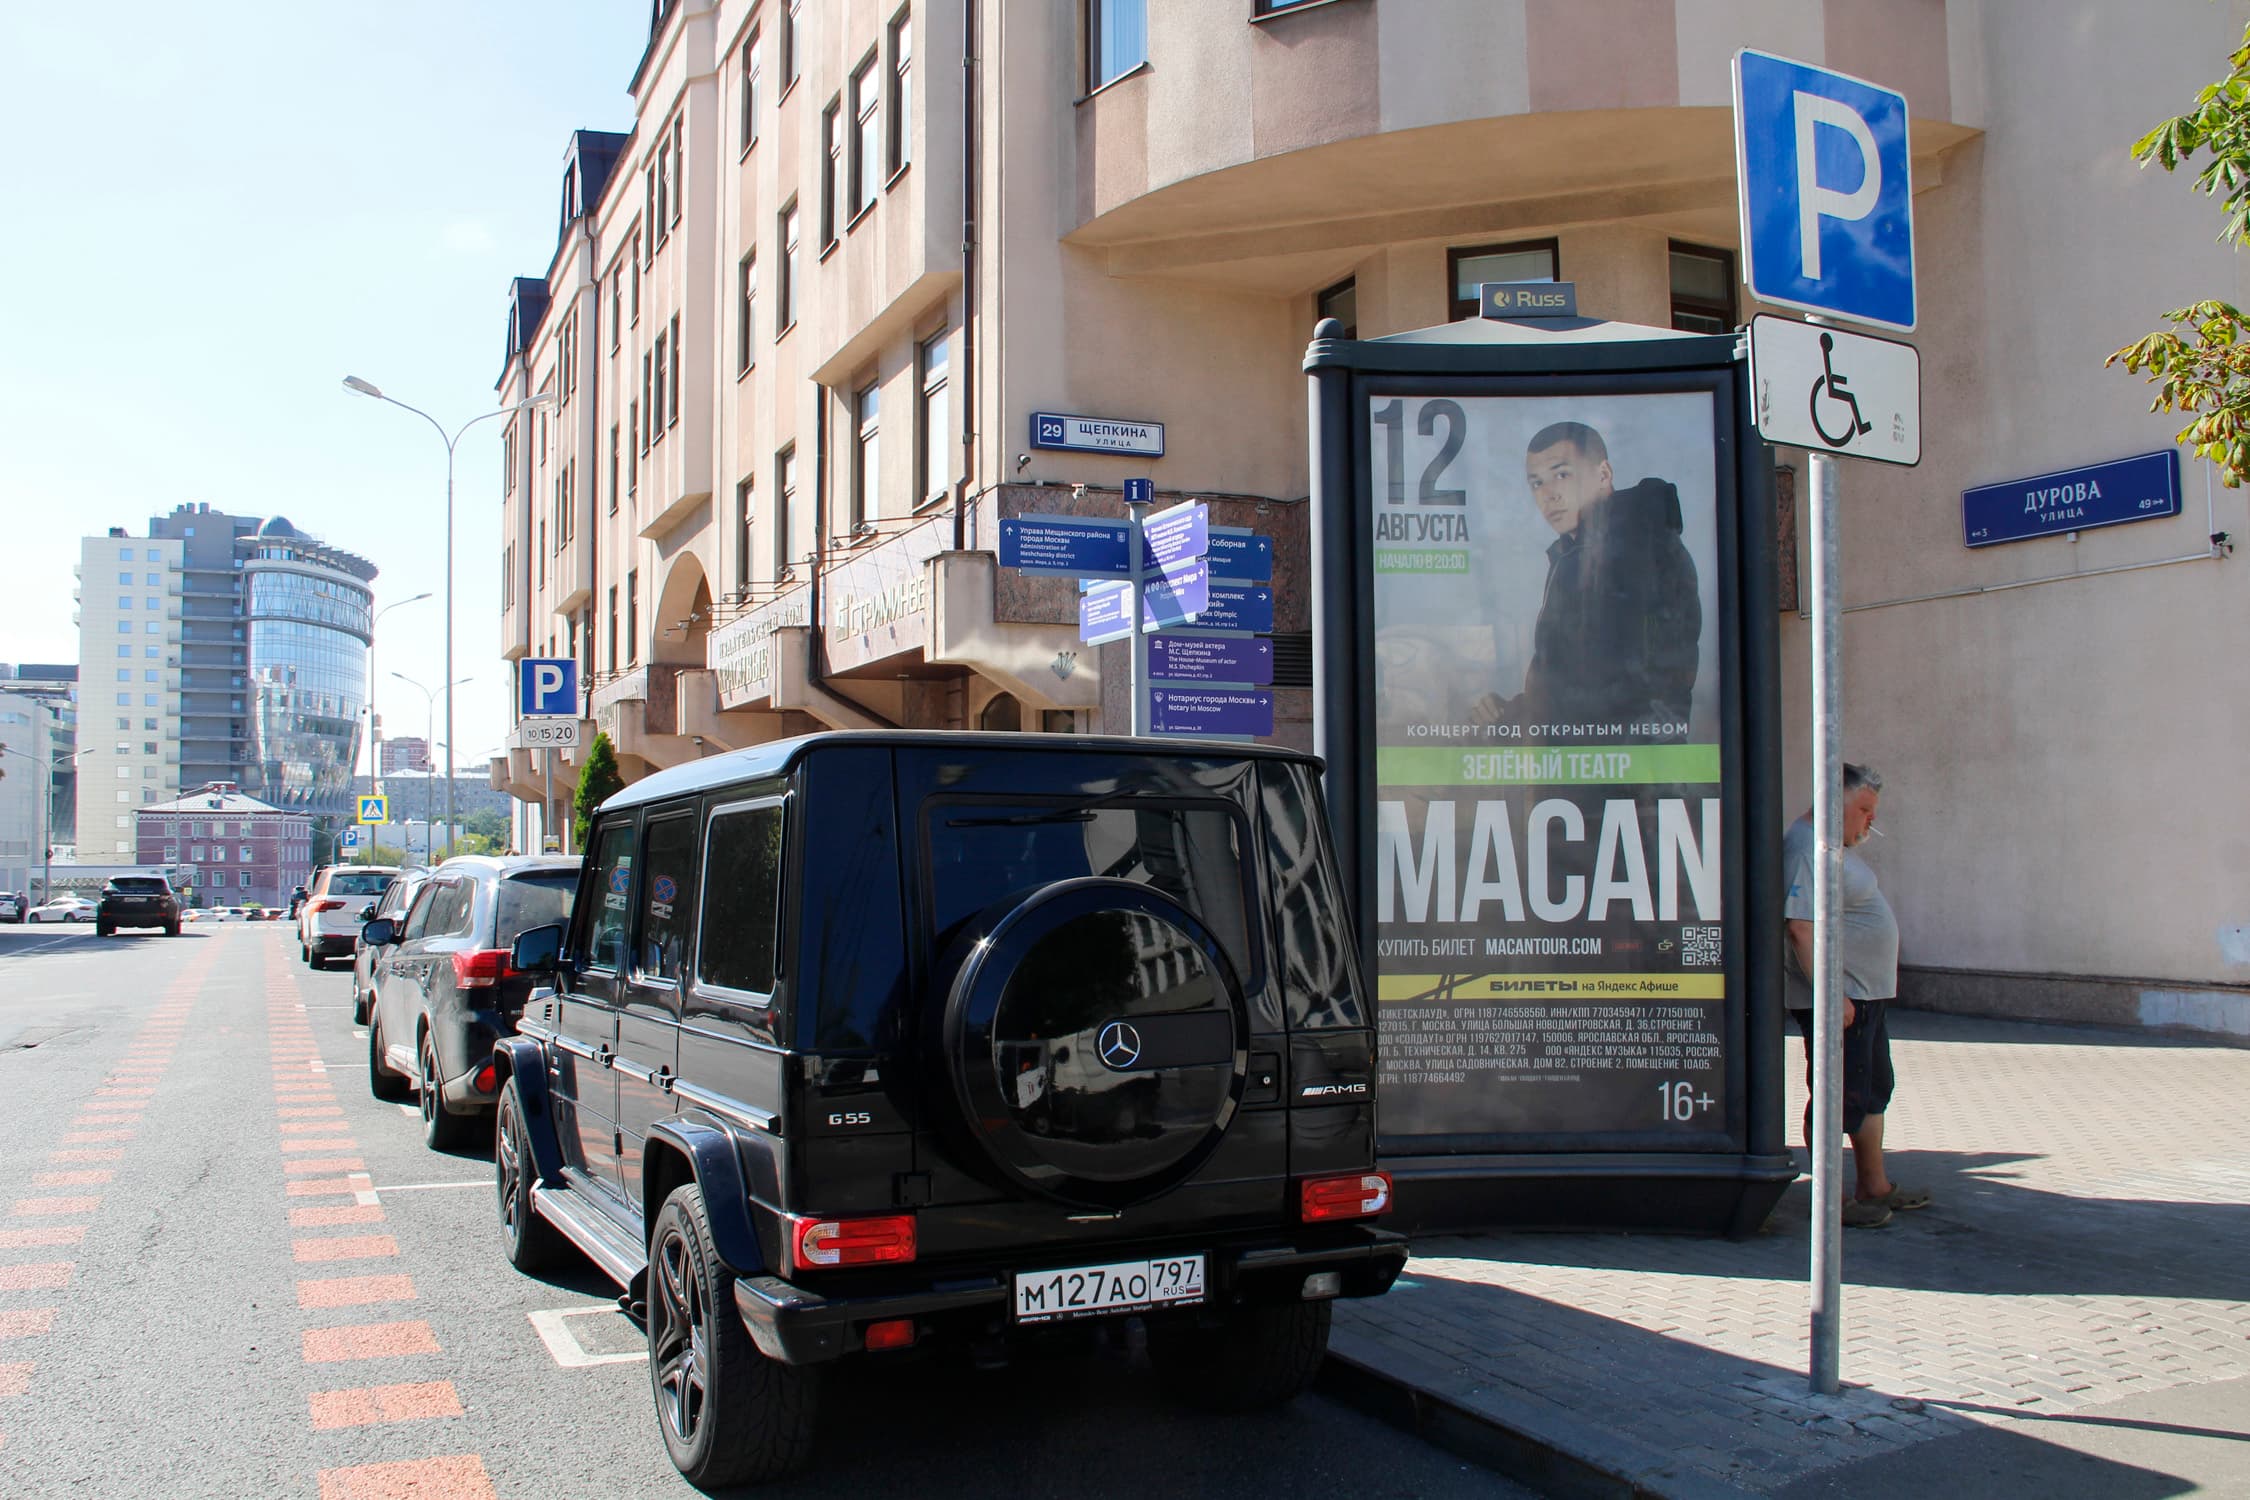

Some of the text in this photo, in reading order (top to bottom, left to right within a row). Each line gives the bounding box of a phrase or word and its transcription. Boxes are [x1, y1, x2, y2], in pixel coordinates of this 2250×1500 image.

[1793, 90, 1882, 280] P
[1517, 291, 1566, 307] Russ
[1042, 424, 1062, 437] 29
[1080, 423, 1147, 438] ЩЕПКИНА
[1095, 438, 1132, 447] УЛИЦА
[1374, 399, 1466, 506] 12
[2024, 480, 2102, 513] ДУРОВА
[2138, 498, 2151, 509] 49
[2040, 506, 2084, 524] УЛИЦА
[1020, 527, 1111, 540] Управа Мещанского района
[1375, 512, 1470, 542] АВГУСТА
[1982, 528, 1988, 537] 3
[1211, 539, 1246, 549] Соборная
[1379, 553, 1465, 569] НАЧАЛО В 20:00
[1212, 592, 1245, 600] комплекс
[1168, 641, 1204, 649] Дом-музей
[534, 664, 564, 710] P
[1168, 694, 1256, 704] Нотариус города Москвы
[1168, 704, 1189, 713] Notary
[541, 728, 551, 738] 15
[555, 727, 573, 739] 20
[1407, 722, 1688, 738] КОНЦЕРТ ПОД ОТКРЫТЫМ НЕБОМ
[1463, 749, 1632, 780] ЗЕЛЁНЫЙ ТЕАТР
[1378, 798, 1721, 923] MACAN
[1377, 938, 1476, 956] КУПИТЬ БИЛЕТ
[1486, 937, 1602, 955] MACANTOUR.COM
[1490, 980, 1679, 992] БИЛЕТЫ на Яндекс Афише
[1454, 1008, 1475, 1018] ОГРН
[1550, 1007, 1590, 1018] ИНН/КПП
[1593, 1006, 1646, 1018] 7703459471
[1461, 1019, 1490, 1031] УЛИЦА
[1492, 1019, 1534, 1030] БОЛЬШАЯ
[1446, 1032, 1467, 1043] ОГРН
[1577, 1031, 1639, 1043] ЯРОСЛАВСКАЯ
[1666, 1032, 1720, 1044] ЯРОСЛАВЛЬ,
[1510, 1044, 1526, 1055] 275
[1545, 1045, 1562, 1056] ООО
[1564, 1045, 1603, 1056] «ЯНДЕКС
[1604, 1046, 1647, 1056] МУЗЫКА»
[1425, 1059, 1455, 1070] УЛИЦА
[1533, 1058, 1553, 1069] ДОМ
[1570, 1057, 1614, 1069] СТРОЕНИЕ
[1626, 1058, 1680, 1070] ПОМЕЩЕНИЕ
[1322, 1083, 1366, 1095] AMG
[1658, 1081, 1715, 1120] 16+
[829, 1112, 871, 1125] G 55
[1024, 1259, 1197, 1312] М127АО 797
[1163, 1286, 1185, 1296] RUS
